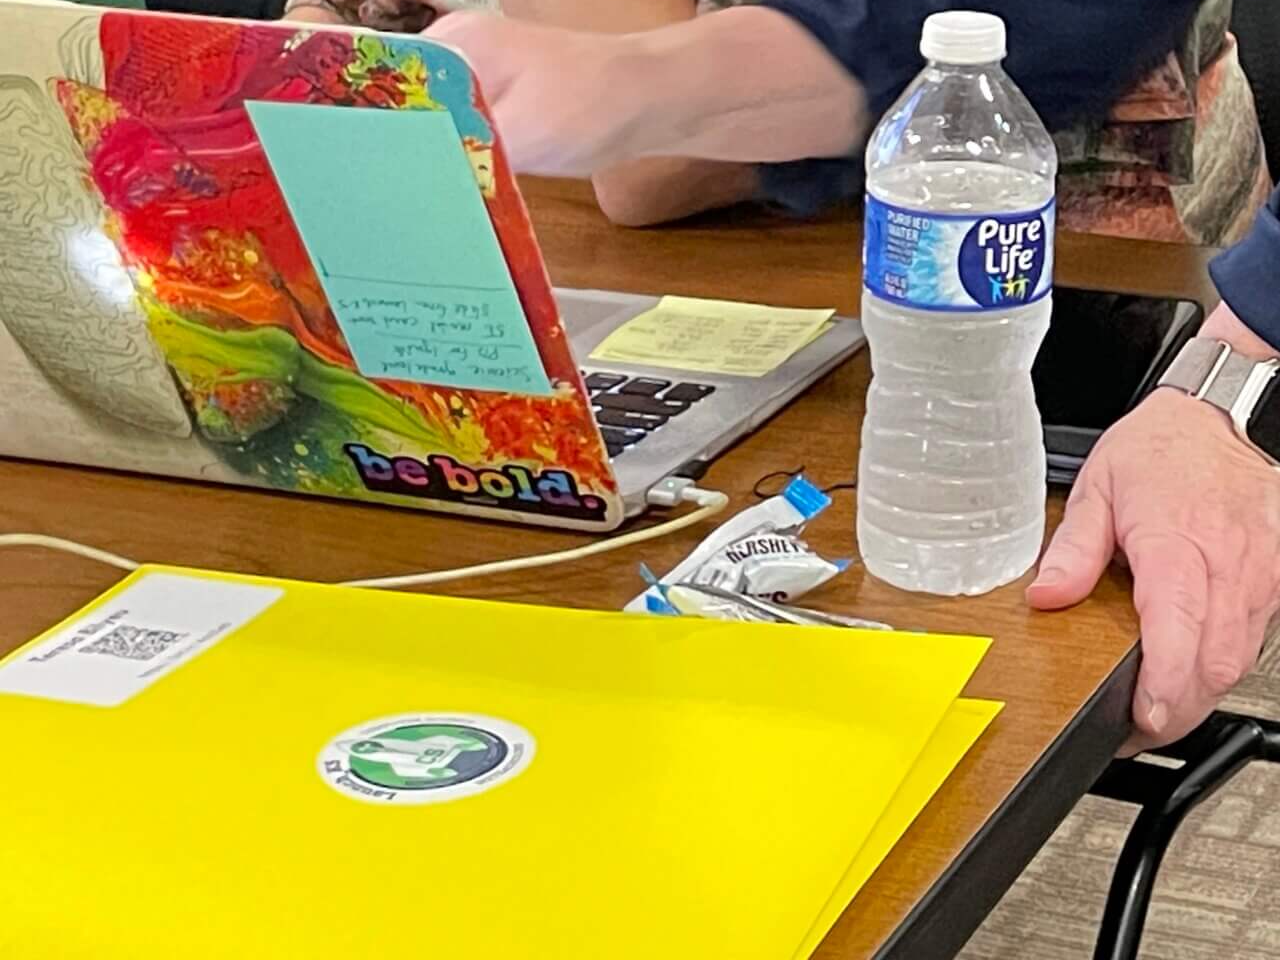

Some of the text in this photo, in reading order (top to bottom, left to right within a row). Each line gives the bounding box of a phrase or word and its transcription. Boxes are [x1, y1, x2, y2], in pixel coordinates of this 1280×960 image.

[978, 219, 1041, 247] Pure
[985, 243, 1035, 279] Life
[346, 444, 429, 486] be
